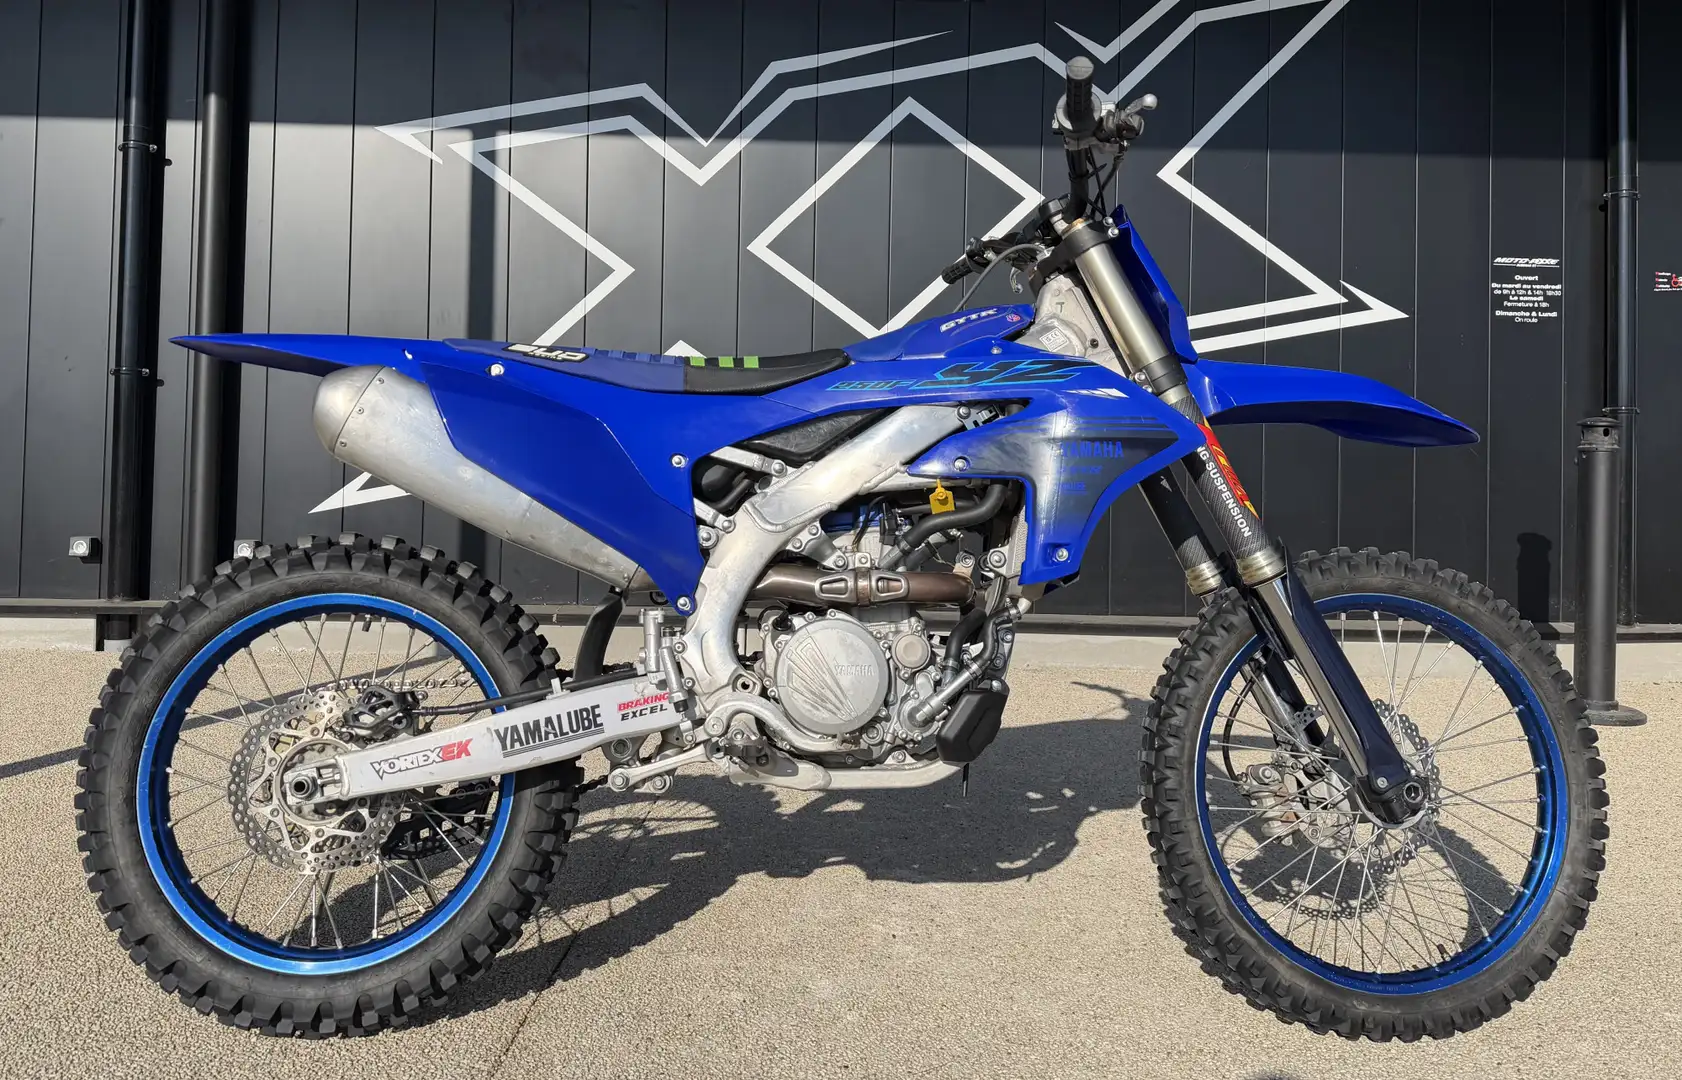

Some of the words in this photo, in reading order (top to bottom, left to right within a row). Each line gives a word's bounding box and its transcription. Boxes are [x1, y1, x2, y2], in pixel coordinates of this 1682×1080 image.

[909, 359, 1102, 390] YZ
[1061, 441, 1124, 458] YAMAHA
[1205, 461, 1252, 538] SUSPENSION
[835, 664, 875, 677] YAMAHA
[618, 692, 670, 711] BRAKING
[620, 704, 668, 721] EXCEL
[494, 704, 603, 751] YAMALUBE
